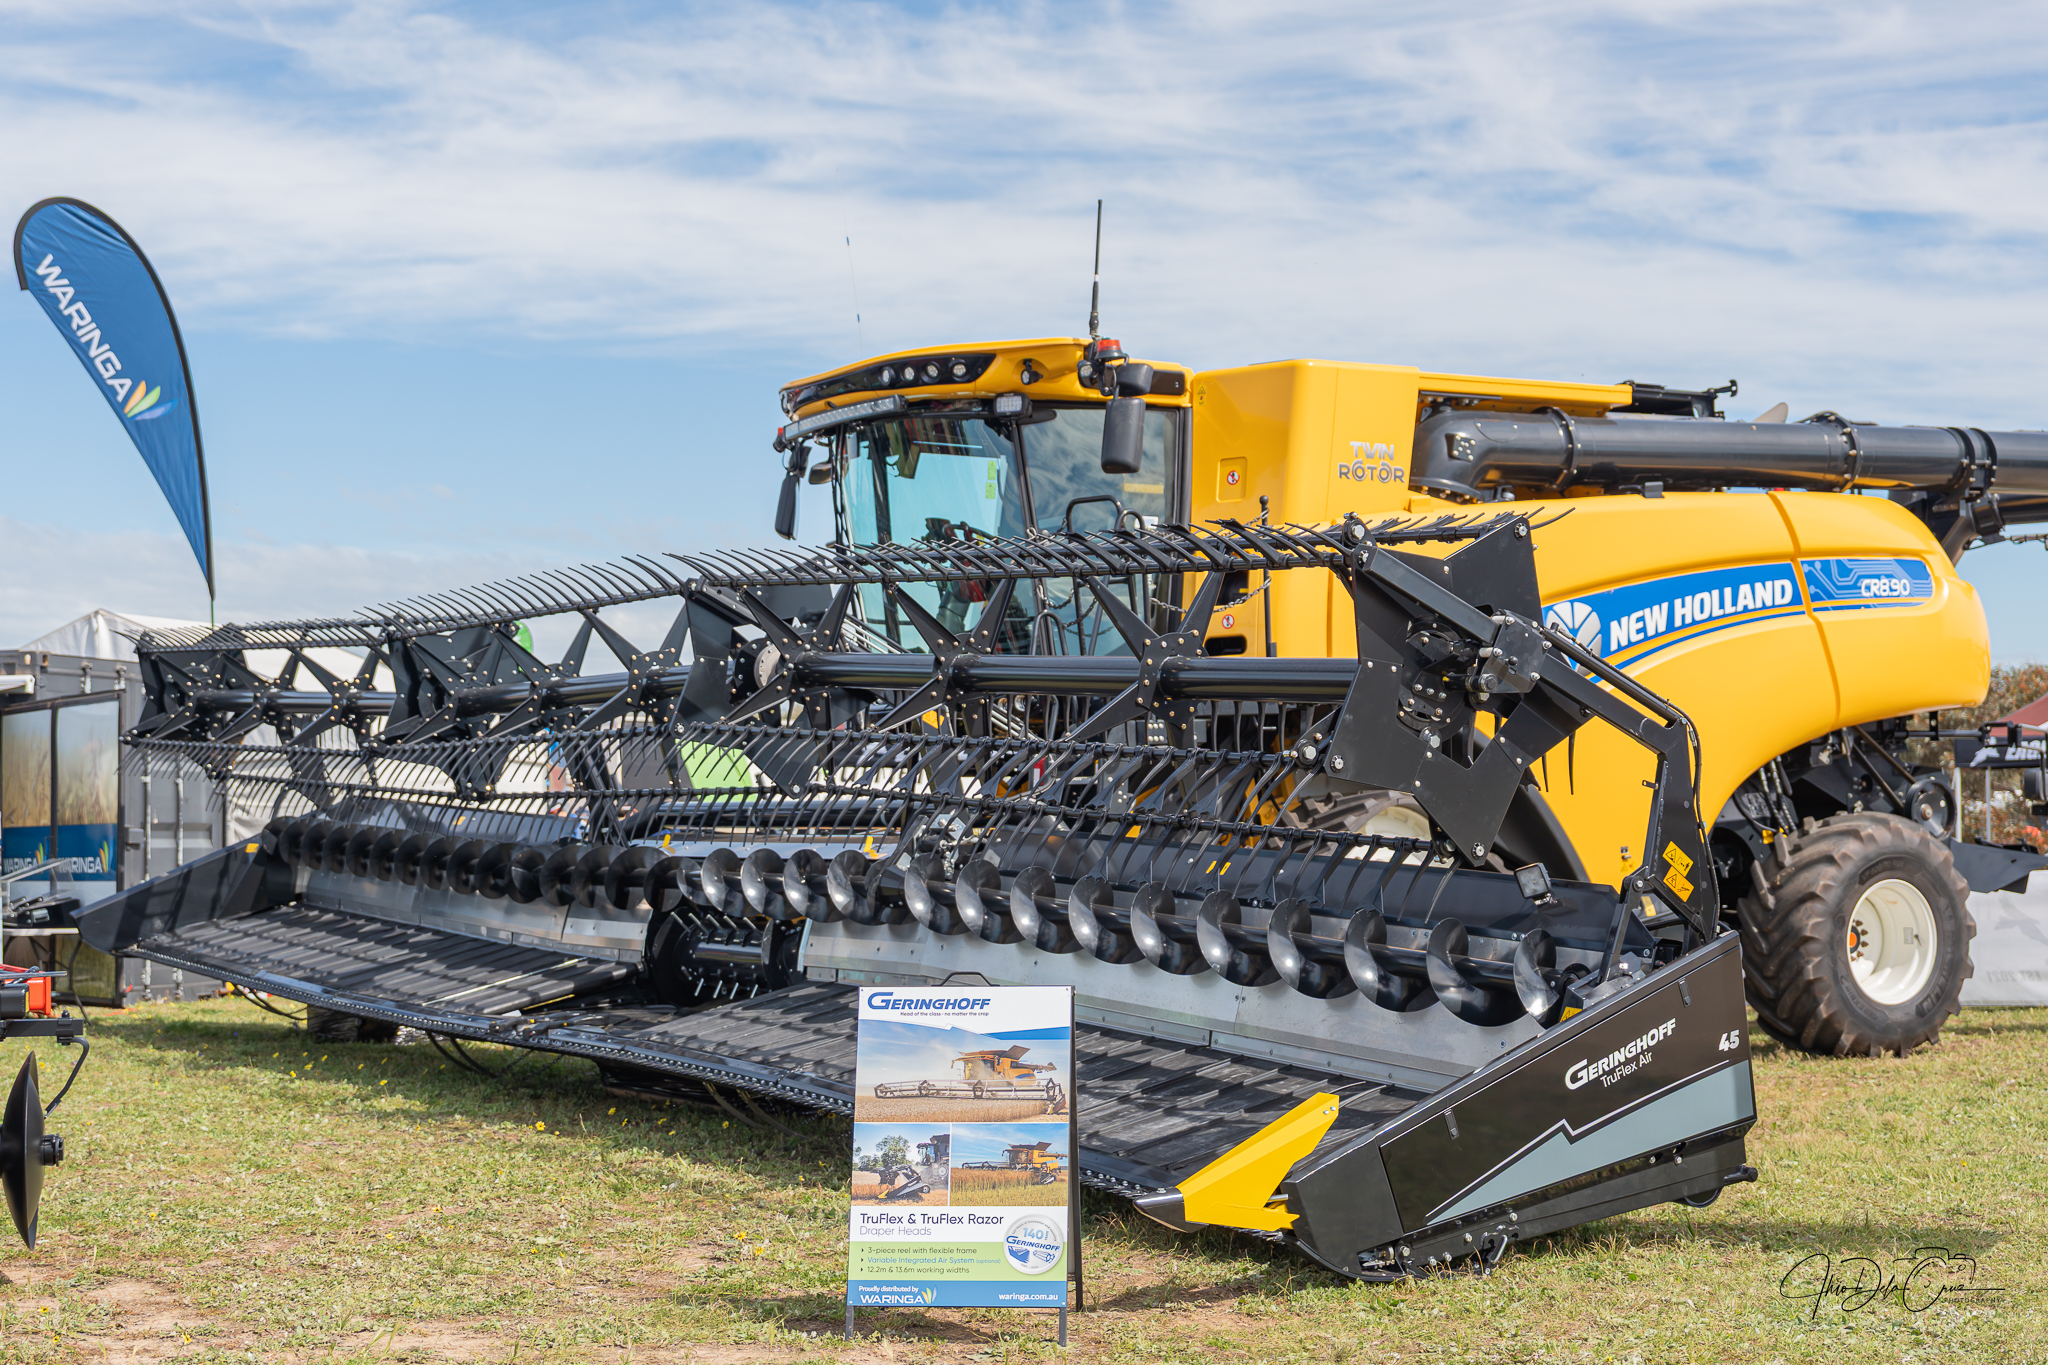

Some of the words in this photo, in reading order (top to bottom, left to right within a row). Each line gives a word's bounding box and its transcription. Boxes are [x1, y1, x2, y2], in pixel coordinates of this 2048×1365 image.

[36, 254, 132, 402] WARINGA
[1350, 441, 1394, 460] TWIN
[1338, 459, 1406, 483] ROTOR
[1860, 578, 1911, 597] CR8.90
[1610, 602, 1669, 652] NEW
[1674, 578, 1793, 627] HOLLAND
[868, 992, 991, 1010] GERINGHOFF
[1719, 1030, 1740, 1051] 45
[1565, 1018, 1676, 1090] GERINGHOFF
[1600, 1061, 1638, 1088] TruFlex
[1639, 1051, 1653, 1068] Air
[860, 1213, 903, 1224] TruFlex
[907, 1214, 916, 1224] &
[920, 1213, 964, 1224] TruFlex
[968, 1214, 1004, 1224] Razor
[860, 1226, 895, 1237] Draper
[898, 1226, 932, 1235] Heads
[1023, 1227, 1044, 1240] 140
[1006, 1235, 1060, 1251] GERINGHOFF
[898, 1257, 936, 1265] Integrated
[949, 1257, 974, 1265] System
[860, 1295, 924, 1304] WARINGA
[998, 1292, 1059, 1301] waringa.com.au
